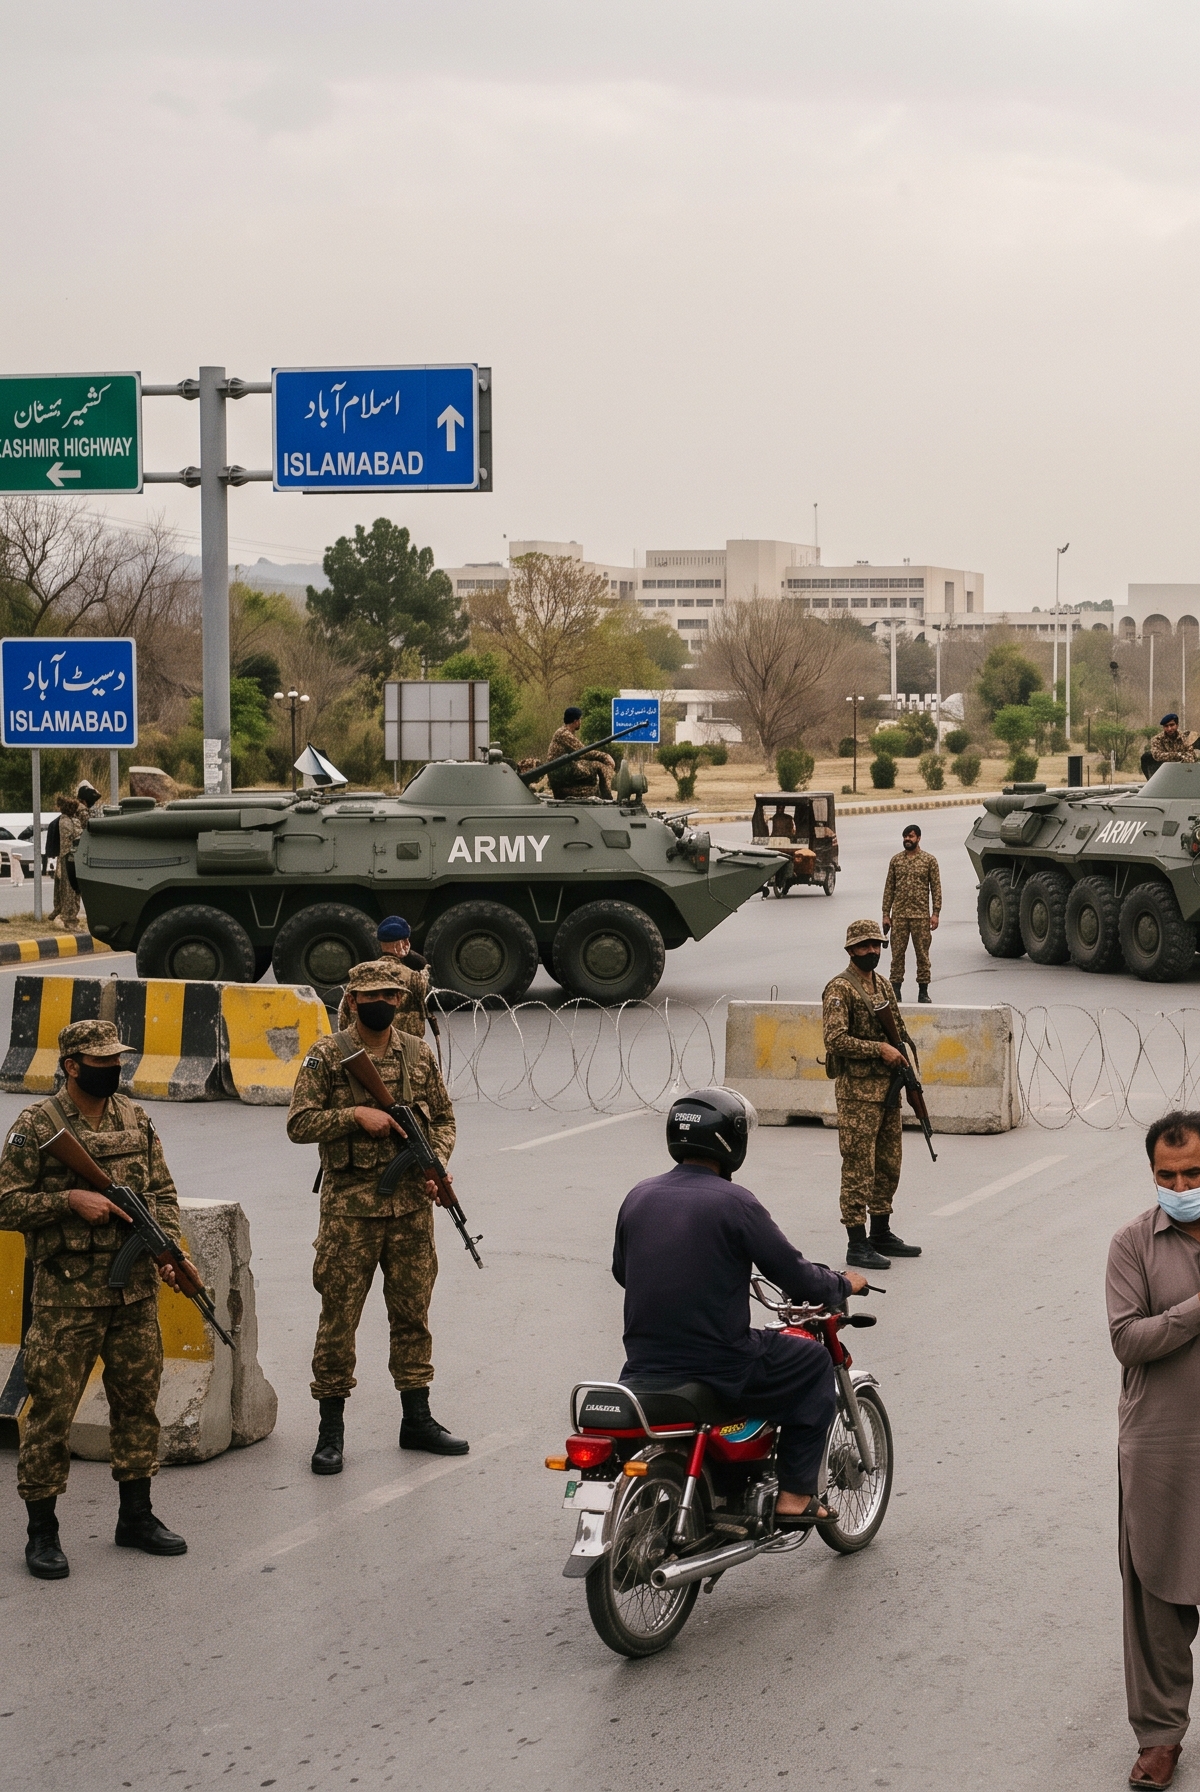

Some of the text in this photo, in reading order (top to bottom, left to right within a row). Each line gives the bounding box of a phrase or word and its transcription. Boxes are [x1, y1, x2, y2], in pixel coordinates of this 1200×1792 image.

[61, 383, 112, 429] کشمیر
[304, 380, 400, 434] اسلام آباد
[0, 437, 133, 458] ASHMIR HIGHWAY
[283, 451, 424, 477] ISLAMABAD
[10, 710, 128, 732] ISLAMABAD
[1094, 820, 1148, 845] ARMY
[447, 834, 551, 863] ARMY
